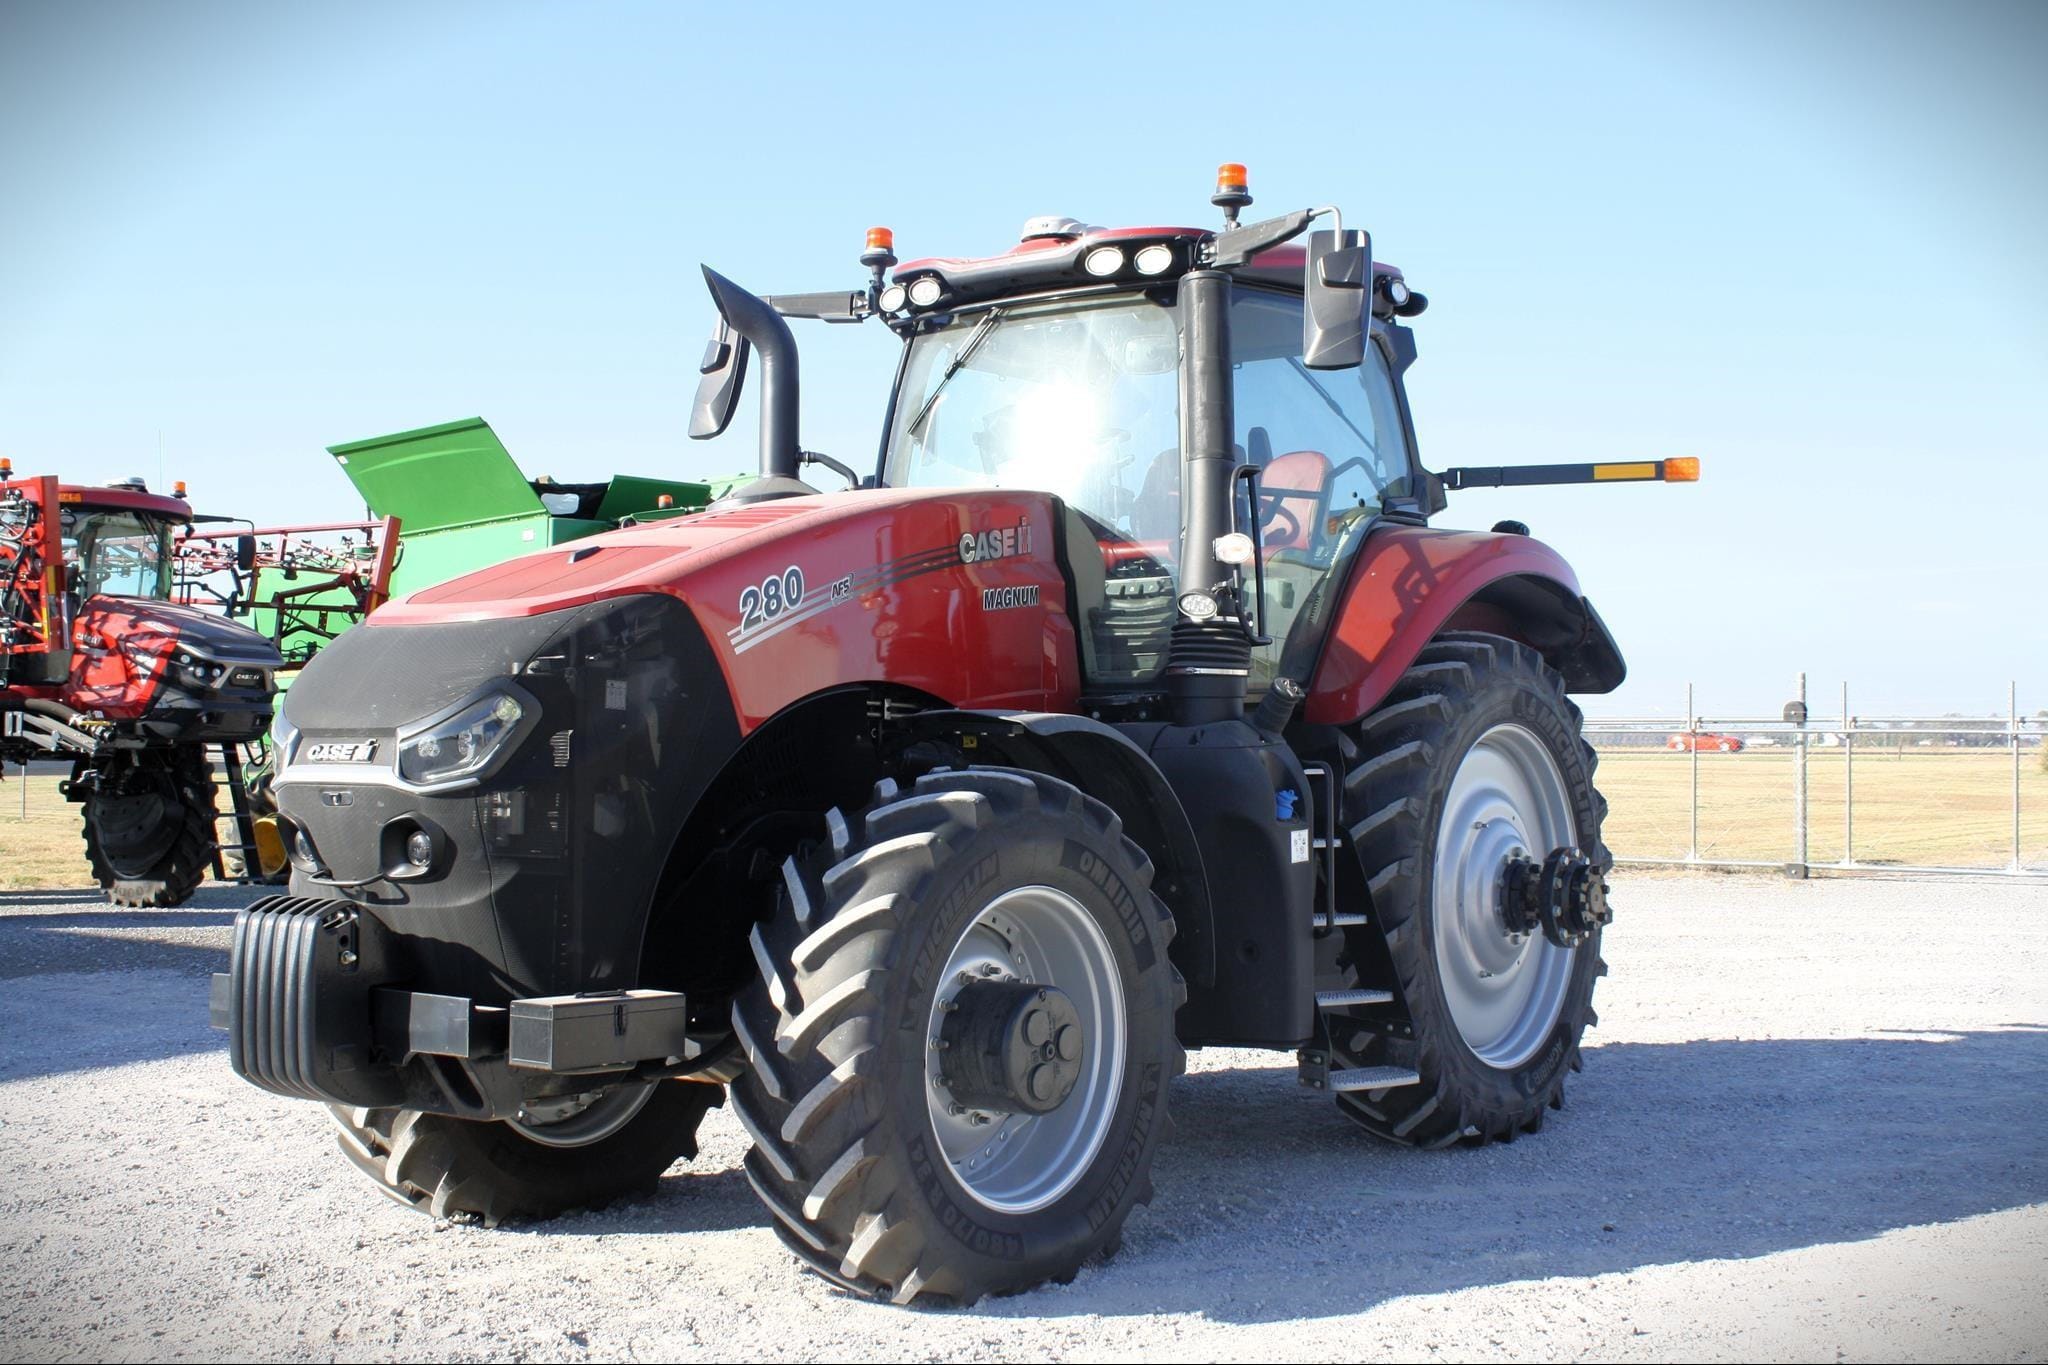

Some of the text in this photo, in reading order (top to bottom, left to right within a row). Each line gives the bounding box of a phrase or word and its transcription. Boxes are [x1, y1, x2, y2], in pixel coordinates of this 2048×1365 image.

[739, 564, 805, 634] 280
[830, 576, 851, 601] AFS
[982, 584, 1040, 611] MAGNUM
[1537, 705, 1595, 835] MICHELIN
[912, 851, 998, 992] MICHELIN
[1079, 850, 1147, 945] OMNIBIB
[1087, 1099, 1153, 1230] MICHELIN
